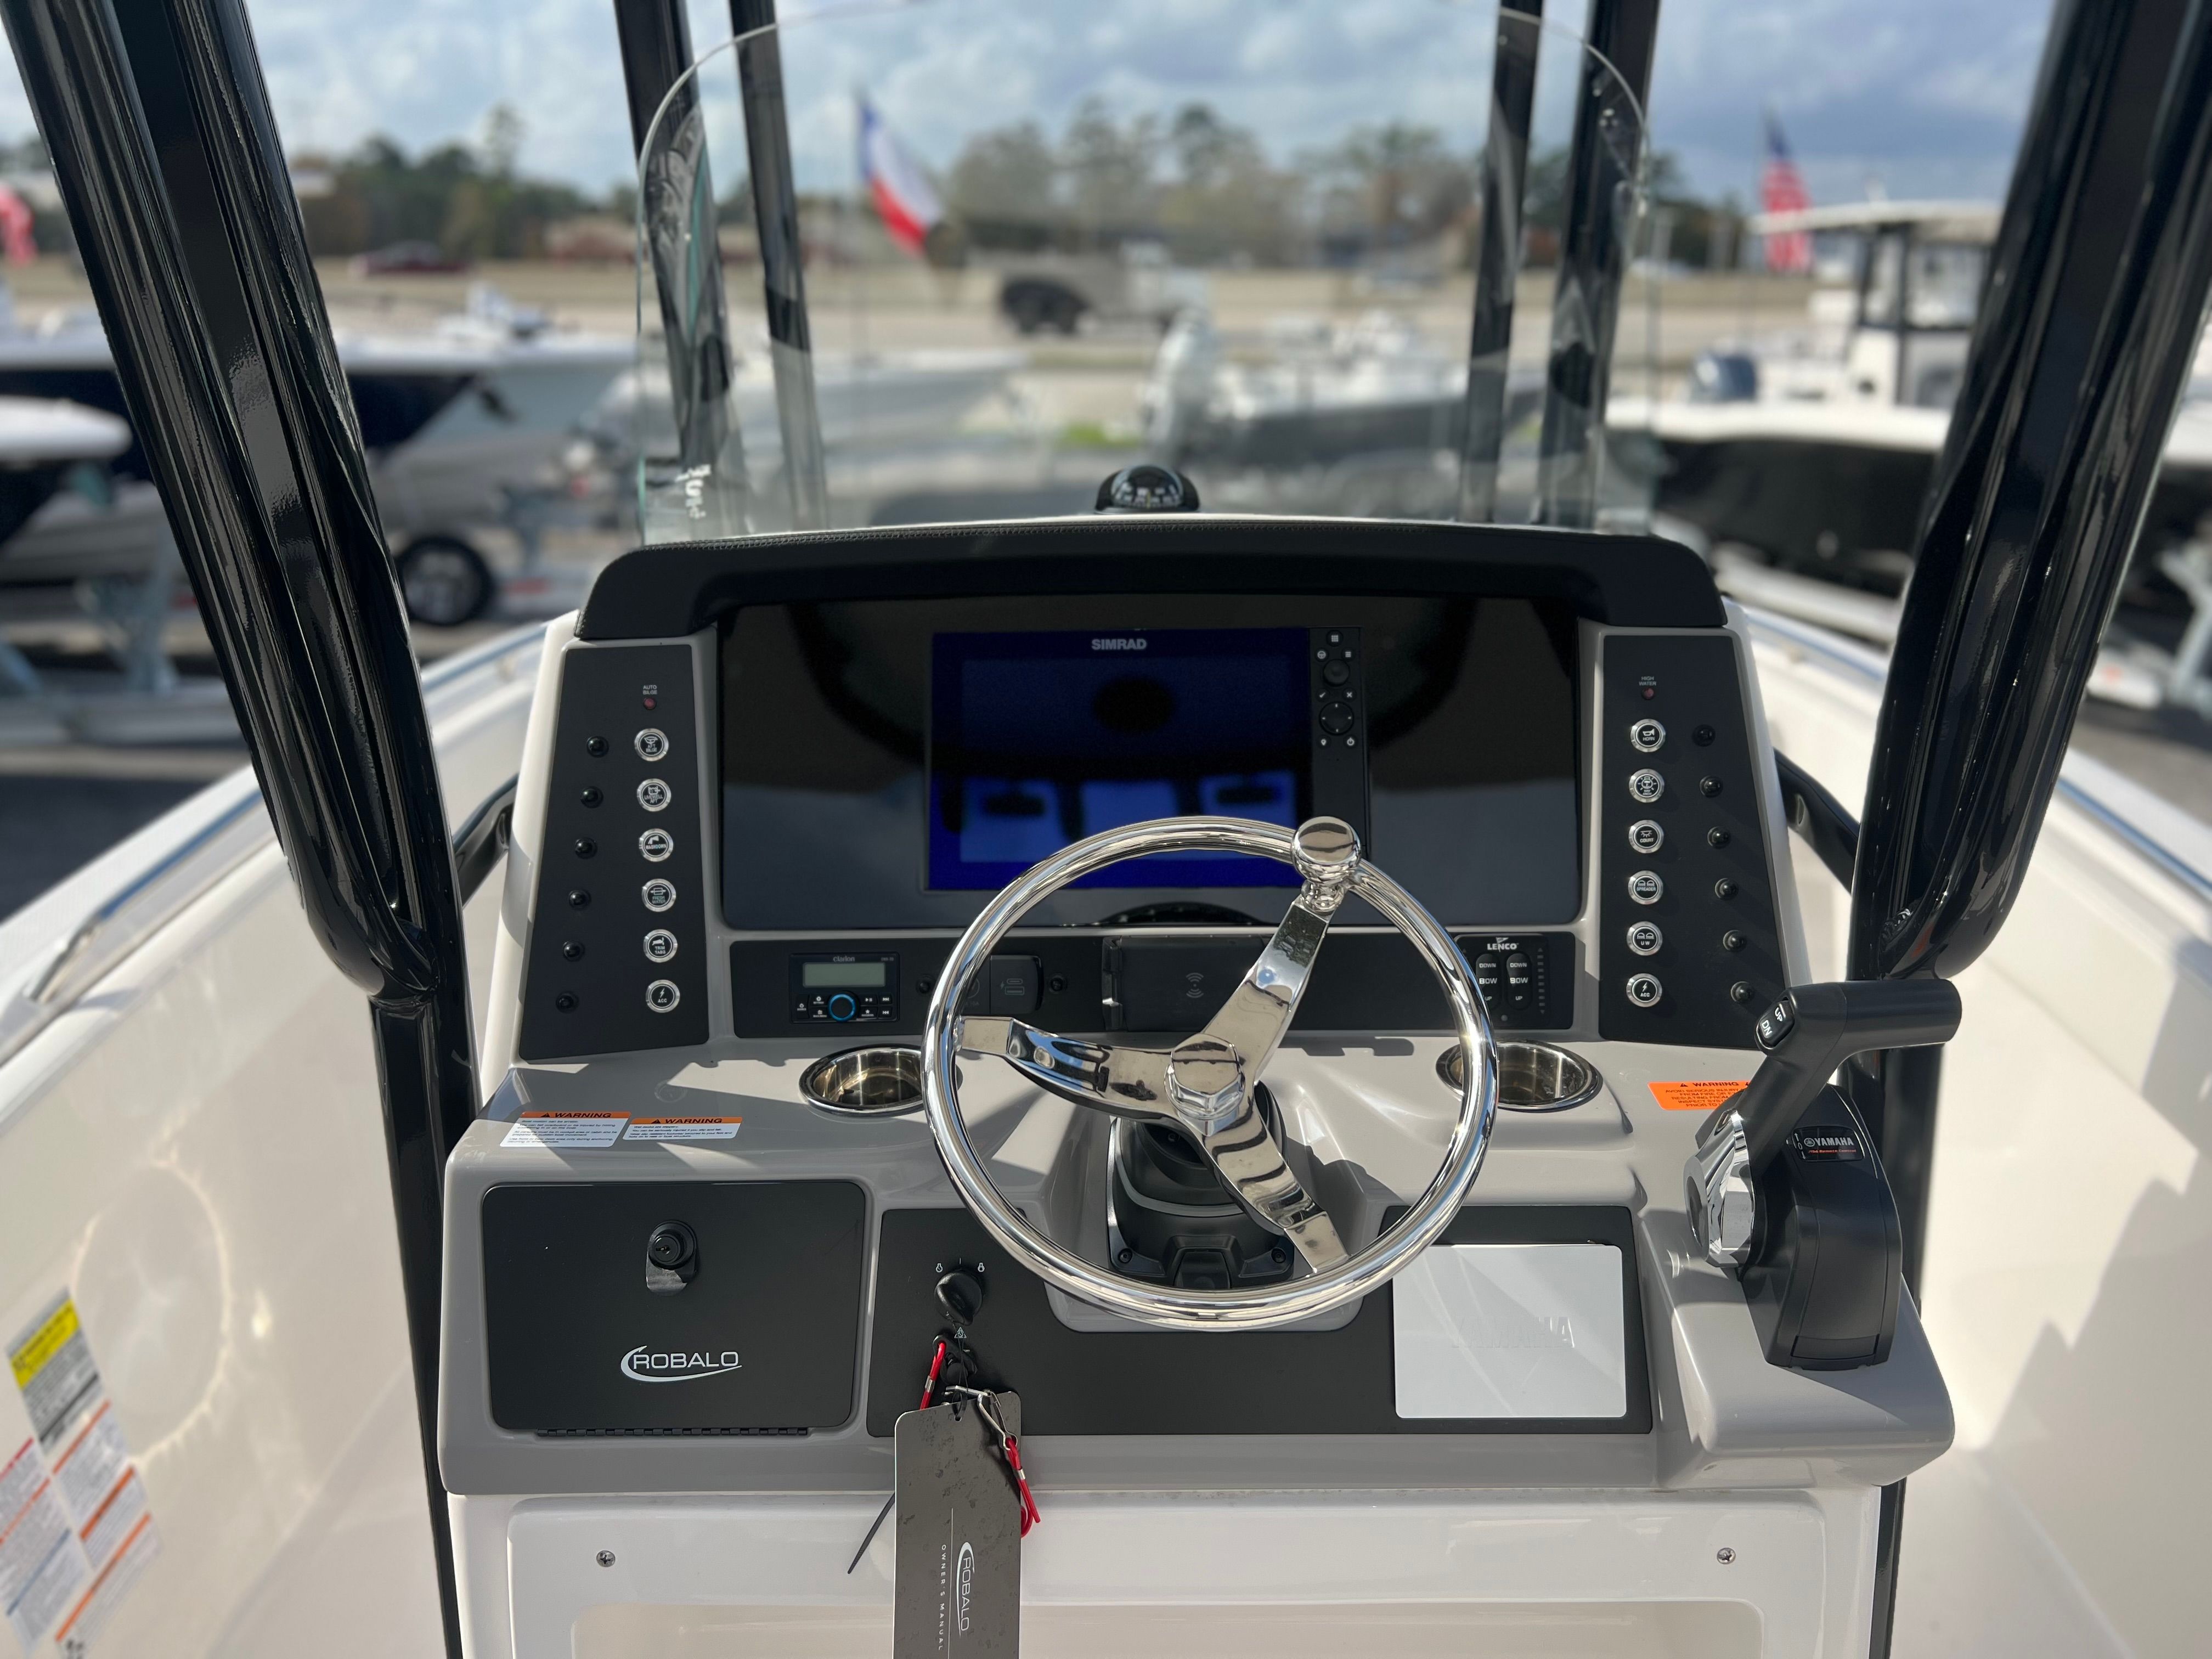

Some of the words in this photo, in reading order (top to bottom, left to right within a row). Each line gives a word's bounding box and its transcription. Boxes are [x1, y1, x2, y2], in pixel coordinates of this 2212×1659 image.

[1091, 638, 1147, 650] SIMRAD
[1487, 943, 1517, 951] LENCO
[1775, 1007, 1783, 1022] UP
[1761, 1019, 1773, 1036] DN
[1814, 1137, 1854, 1146] YAMAHA
[633, 1351, 739, 1369] ROBALO
[961, 1557, 972, 1630] ROBALO
